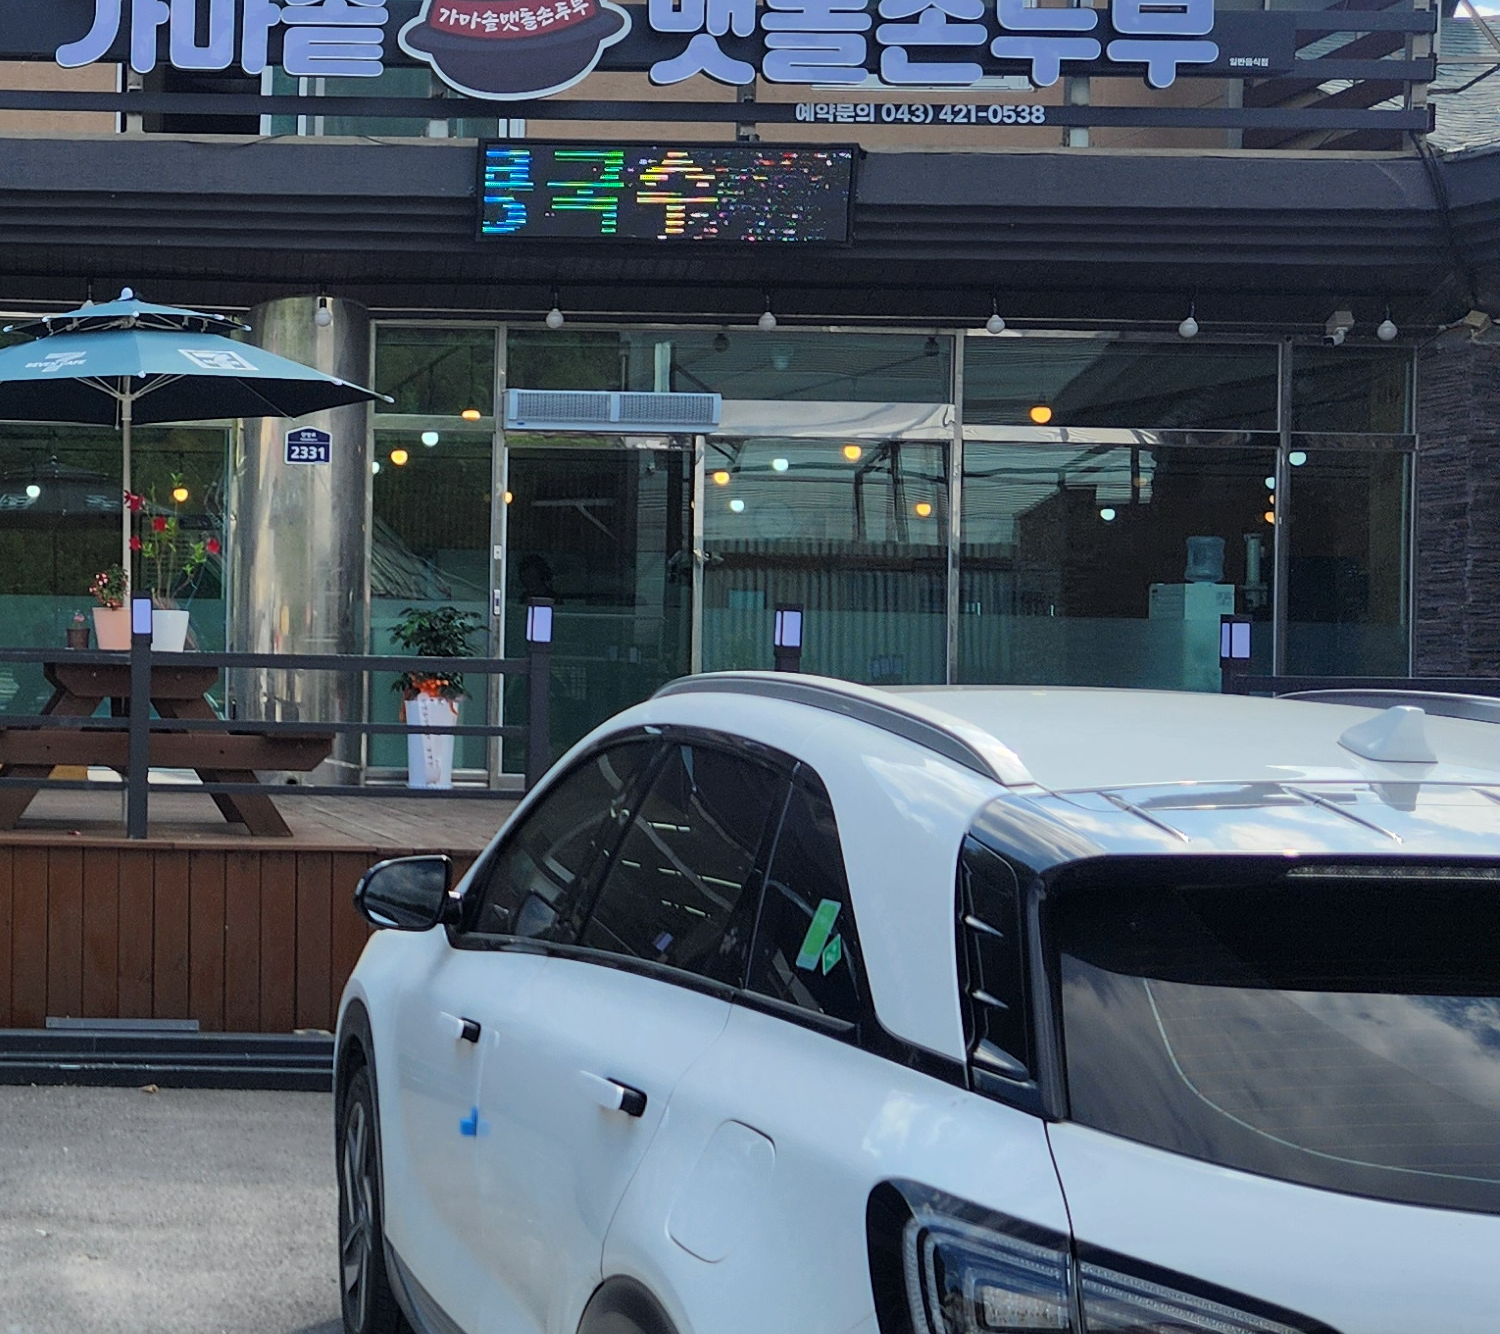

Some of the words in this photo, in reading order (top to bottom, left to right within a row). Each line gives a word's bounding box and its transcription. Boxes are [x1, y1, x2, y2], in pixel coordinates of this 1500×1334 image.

[795, 103, 875, 123] 예약문의
[881, 103, 933, 124] 043)
[938, 104, 1046, 124] 421-0538
[290, 446, 325, 460] 2331
